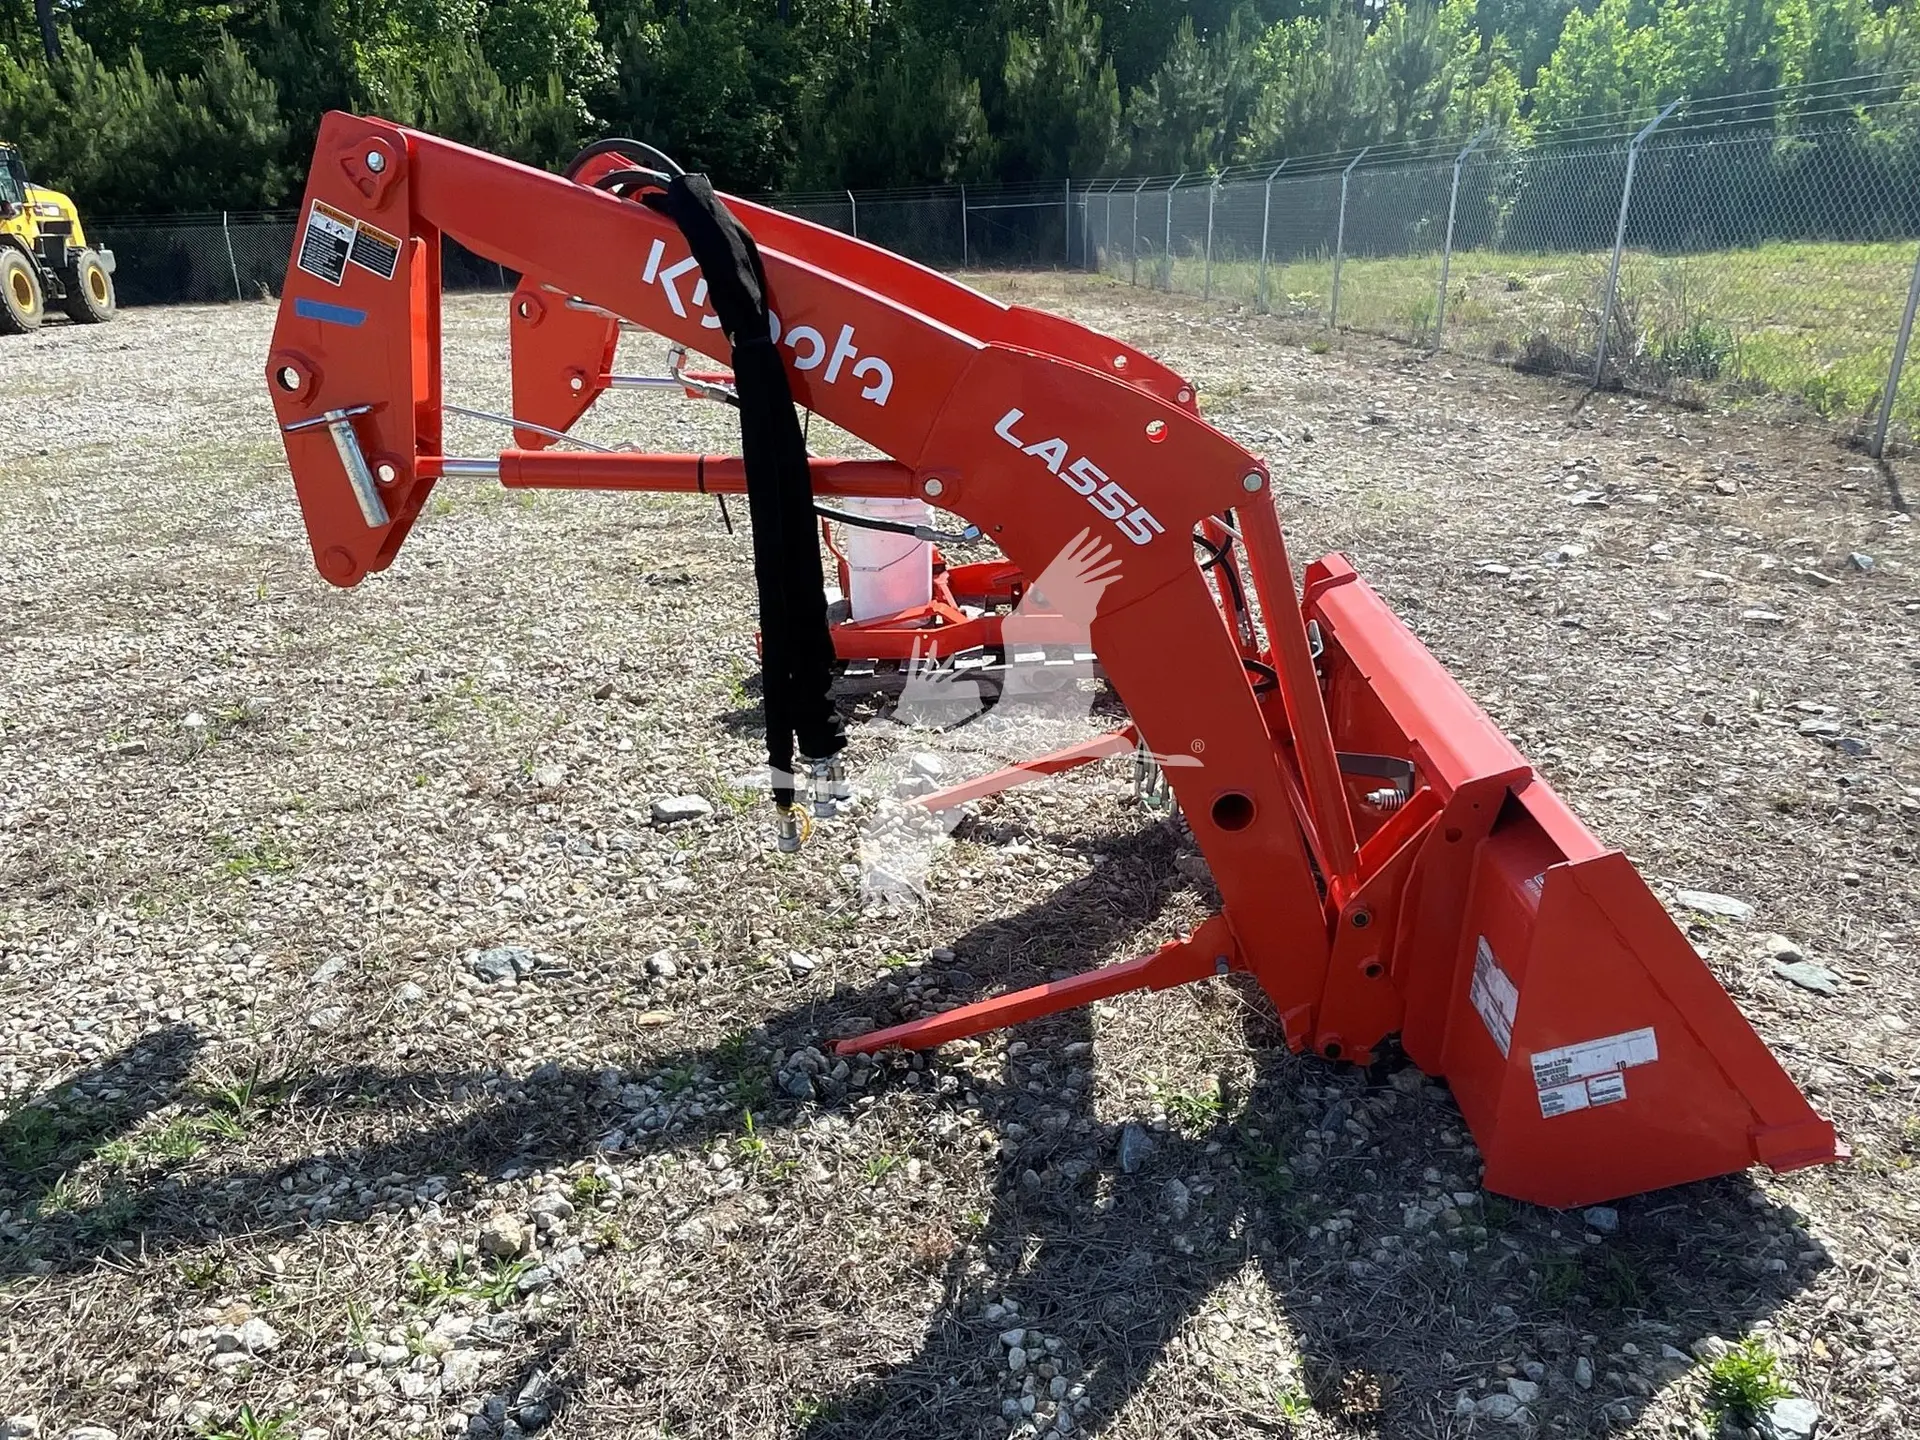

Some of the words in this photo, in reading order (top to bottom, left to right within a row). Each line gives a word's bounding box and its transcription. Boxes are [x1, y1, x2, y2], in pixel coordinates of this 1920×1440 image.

[642, 238, 894, 407] Kuota
[994, 407, 1166, 546] LA555
[1615, 1060, 1626, 1071] 10
